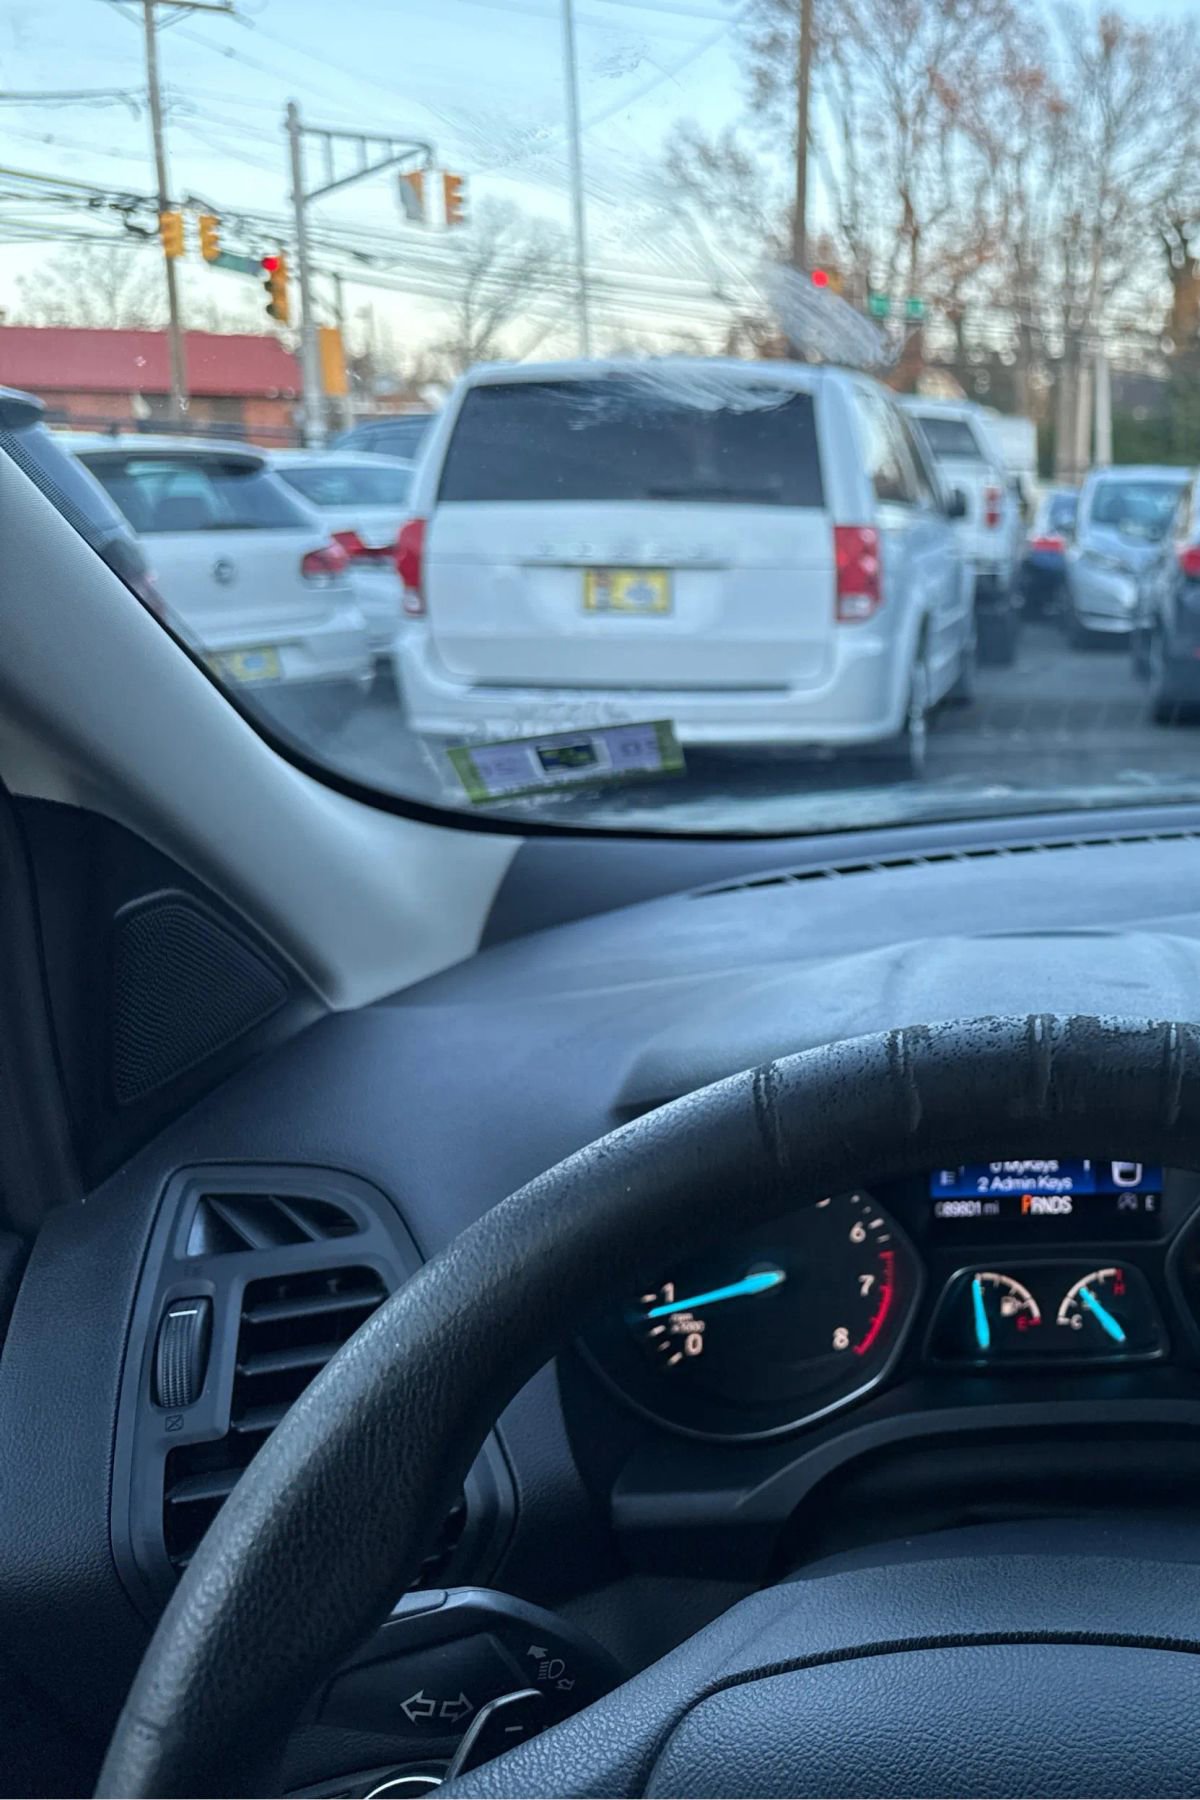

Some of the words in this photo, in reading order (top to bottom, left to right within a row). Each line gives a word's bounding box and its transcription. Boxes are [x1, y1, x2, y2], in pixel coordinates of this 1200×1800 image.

[976, 1176, 990, 1193] 2
[990, 1175, 1036, 1192] Admin
[1037, 1174, 1073, 1193] Keys
[850, 1221, 866, 1243] 6
[858, 1274, 875, 1296] 7
[685, 1333, 703, 1355] 0
[832, 1327, 849, 1350] 8
